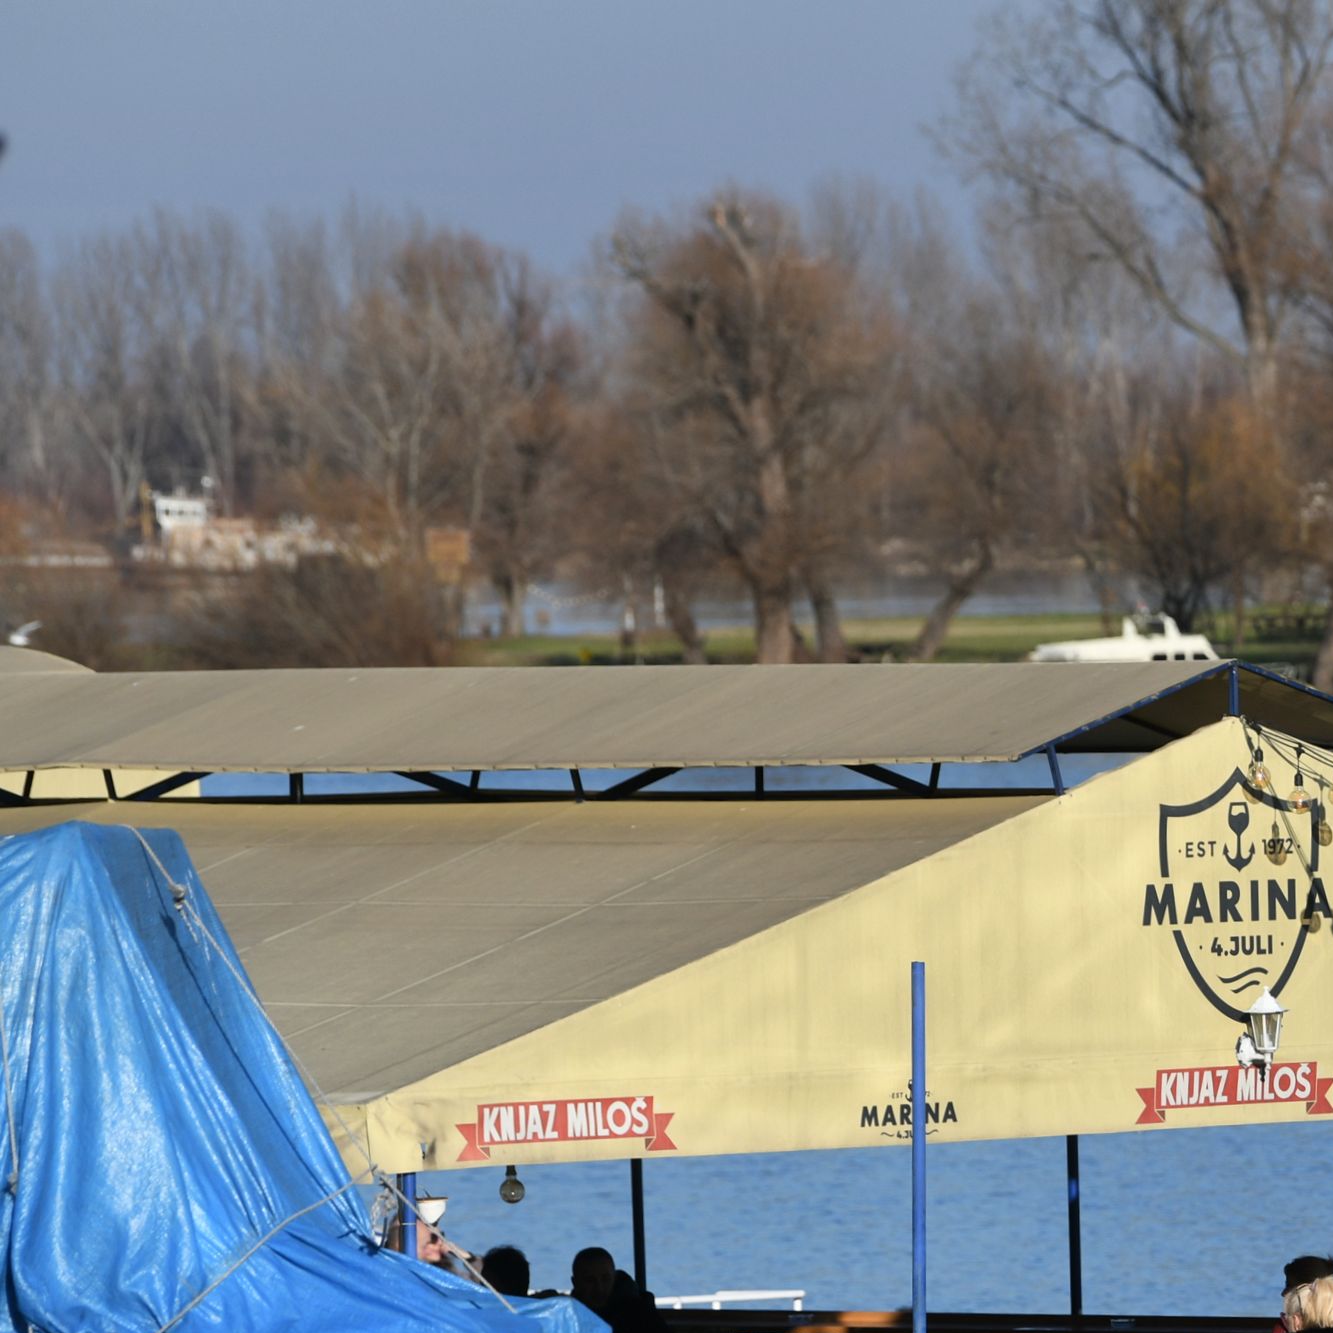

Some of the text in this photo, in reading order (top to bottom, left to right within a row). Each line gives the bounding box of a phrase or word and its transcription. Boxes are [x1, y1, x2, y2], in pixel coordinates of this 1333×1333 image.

[1185, 838, 1294, 858] EST 1972
[1142, 877, 1333, 926] MARINA
[1210, 935, 1273, 956] 4.JULI
[1160, 1062, 1312, 1107] KNJAZ MILOŠ
[482, 1096, 649, 1143] KNJAZ MILOŠ
[860, 1101, 958, 1128] MARNA
